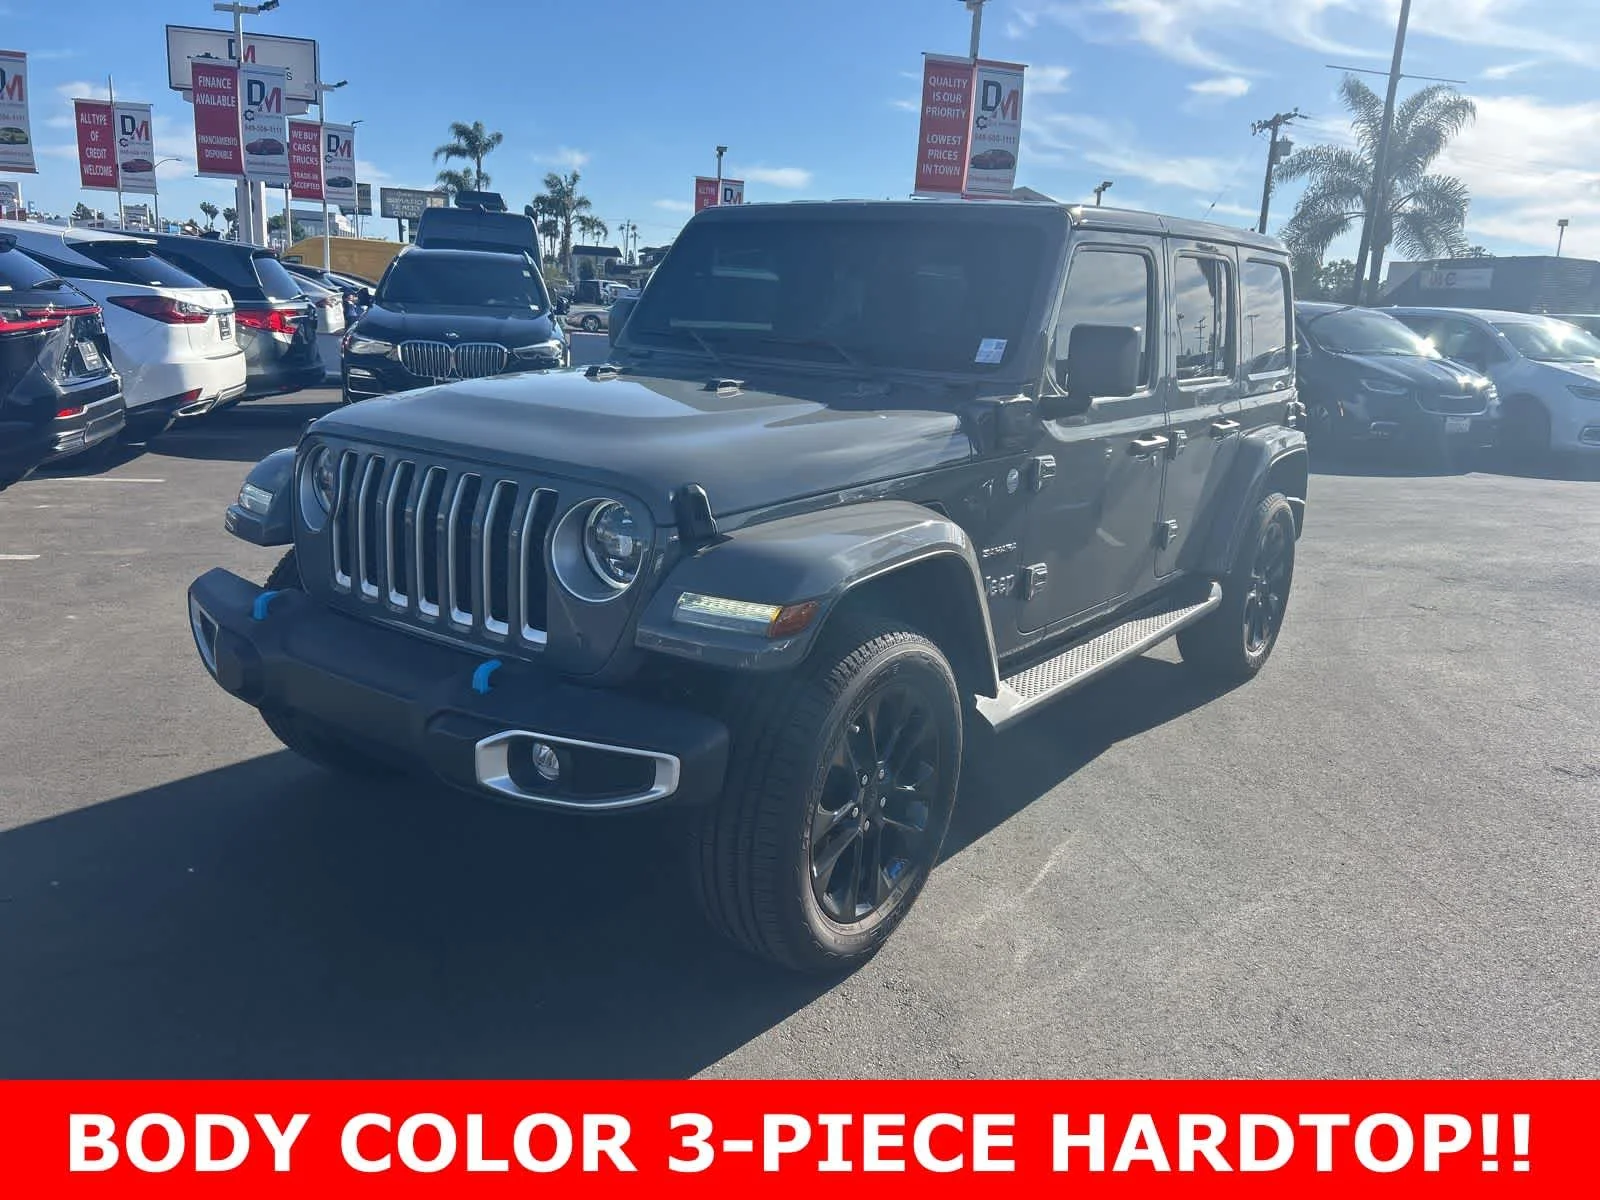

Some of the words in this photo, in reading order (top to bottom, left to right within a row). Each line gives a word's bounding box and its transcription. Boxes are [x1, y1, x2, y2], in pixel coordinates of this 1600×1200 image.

[198, 75, 232, 89] FINANCE
[929, 76, 968, 89] QUALITY
[196, 94, 236, 108] AVAILABLE
[932, 92, 940, 102] IS
[942, 93, 962, 104] OUR
[926, 106, 966, 119] PRIORITY
[90, 130, 99, 142] OF
[292, 130, 302, 139] WE
[304, 131, 318, 140] BUY
[926, 134, 962, 145] LOWEST
[86, 147, 107, 159] CREDIT
[292, 143, 311, 152] CARS
[292, 155, 318, 166] TRUCKS
[928, 150, 959, 160] PRICES
[83, 164, 113, 176] WELCOME
[922, 165, 932, 174] IN
[933, 165, 960, 176] TOWN
